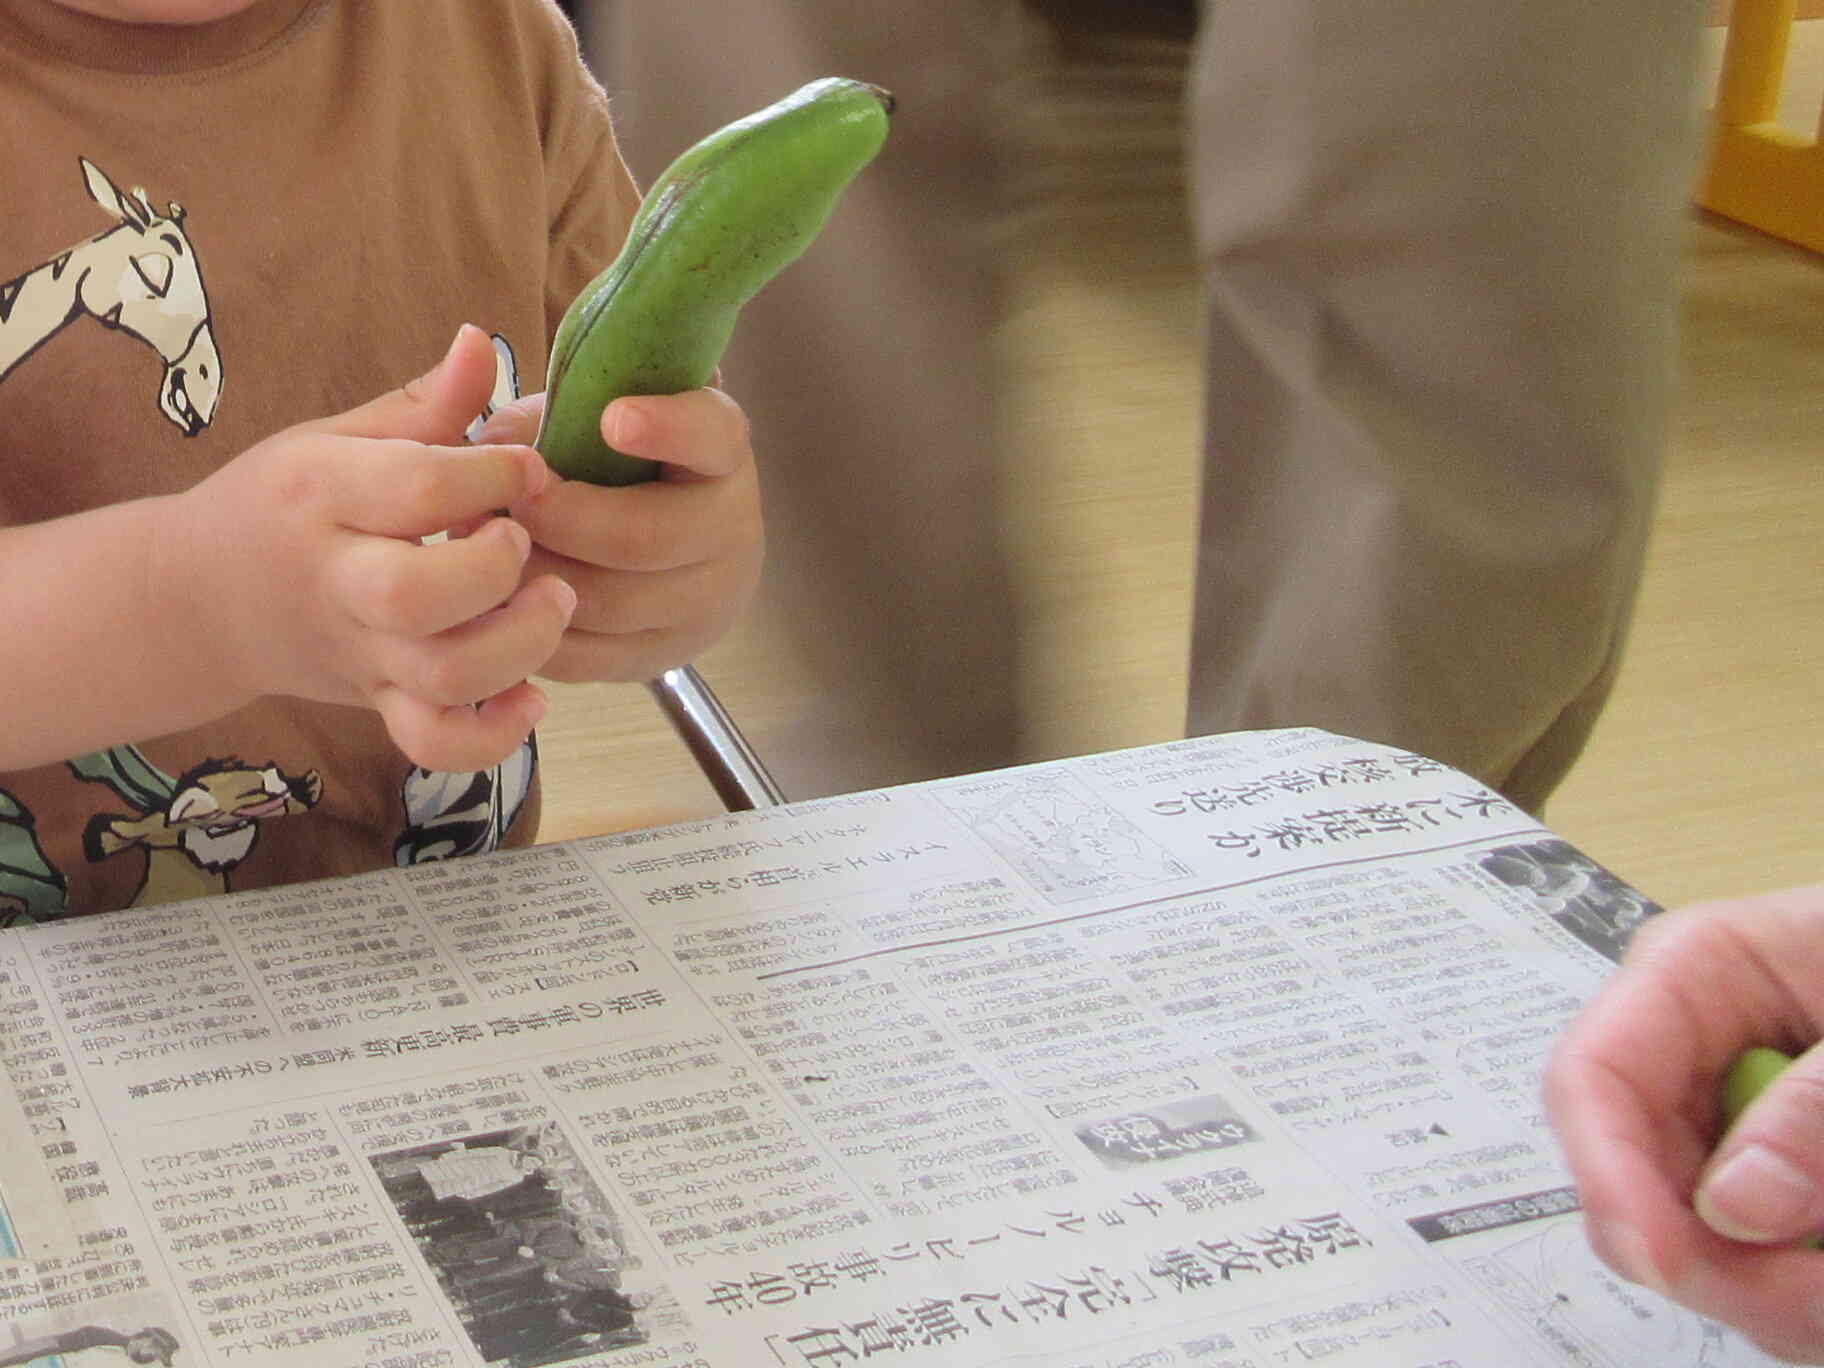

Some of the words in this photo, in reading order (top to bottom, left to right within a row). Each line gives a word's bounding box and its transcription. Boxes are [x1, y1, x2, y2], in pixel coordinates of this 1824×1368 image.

[1150, 749, 1388, 822] 核交渉先送り
[1205, 784, 1522, 858] 米に新提案か
[358, 1021, 485, 1060] 最高更新
[484, 986, 668, 1039] 世界の軍事費
[124, 1044, 358, 1101] 米同盟への不安拡大背景
[1126, 1119, 1250, 1161] ウクライナ
[706, 1190, 1146, 1312] チョルノービリ事故40年
[764, 1212, 1376, 1367] 原発攻撃「完全に無責任」
